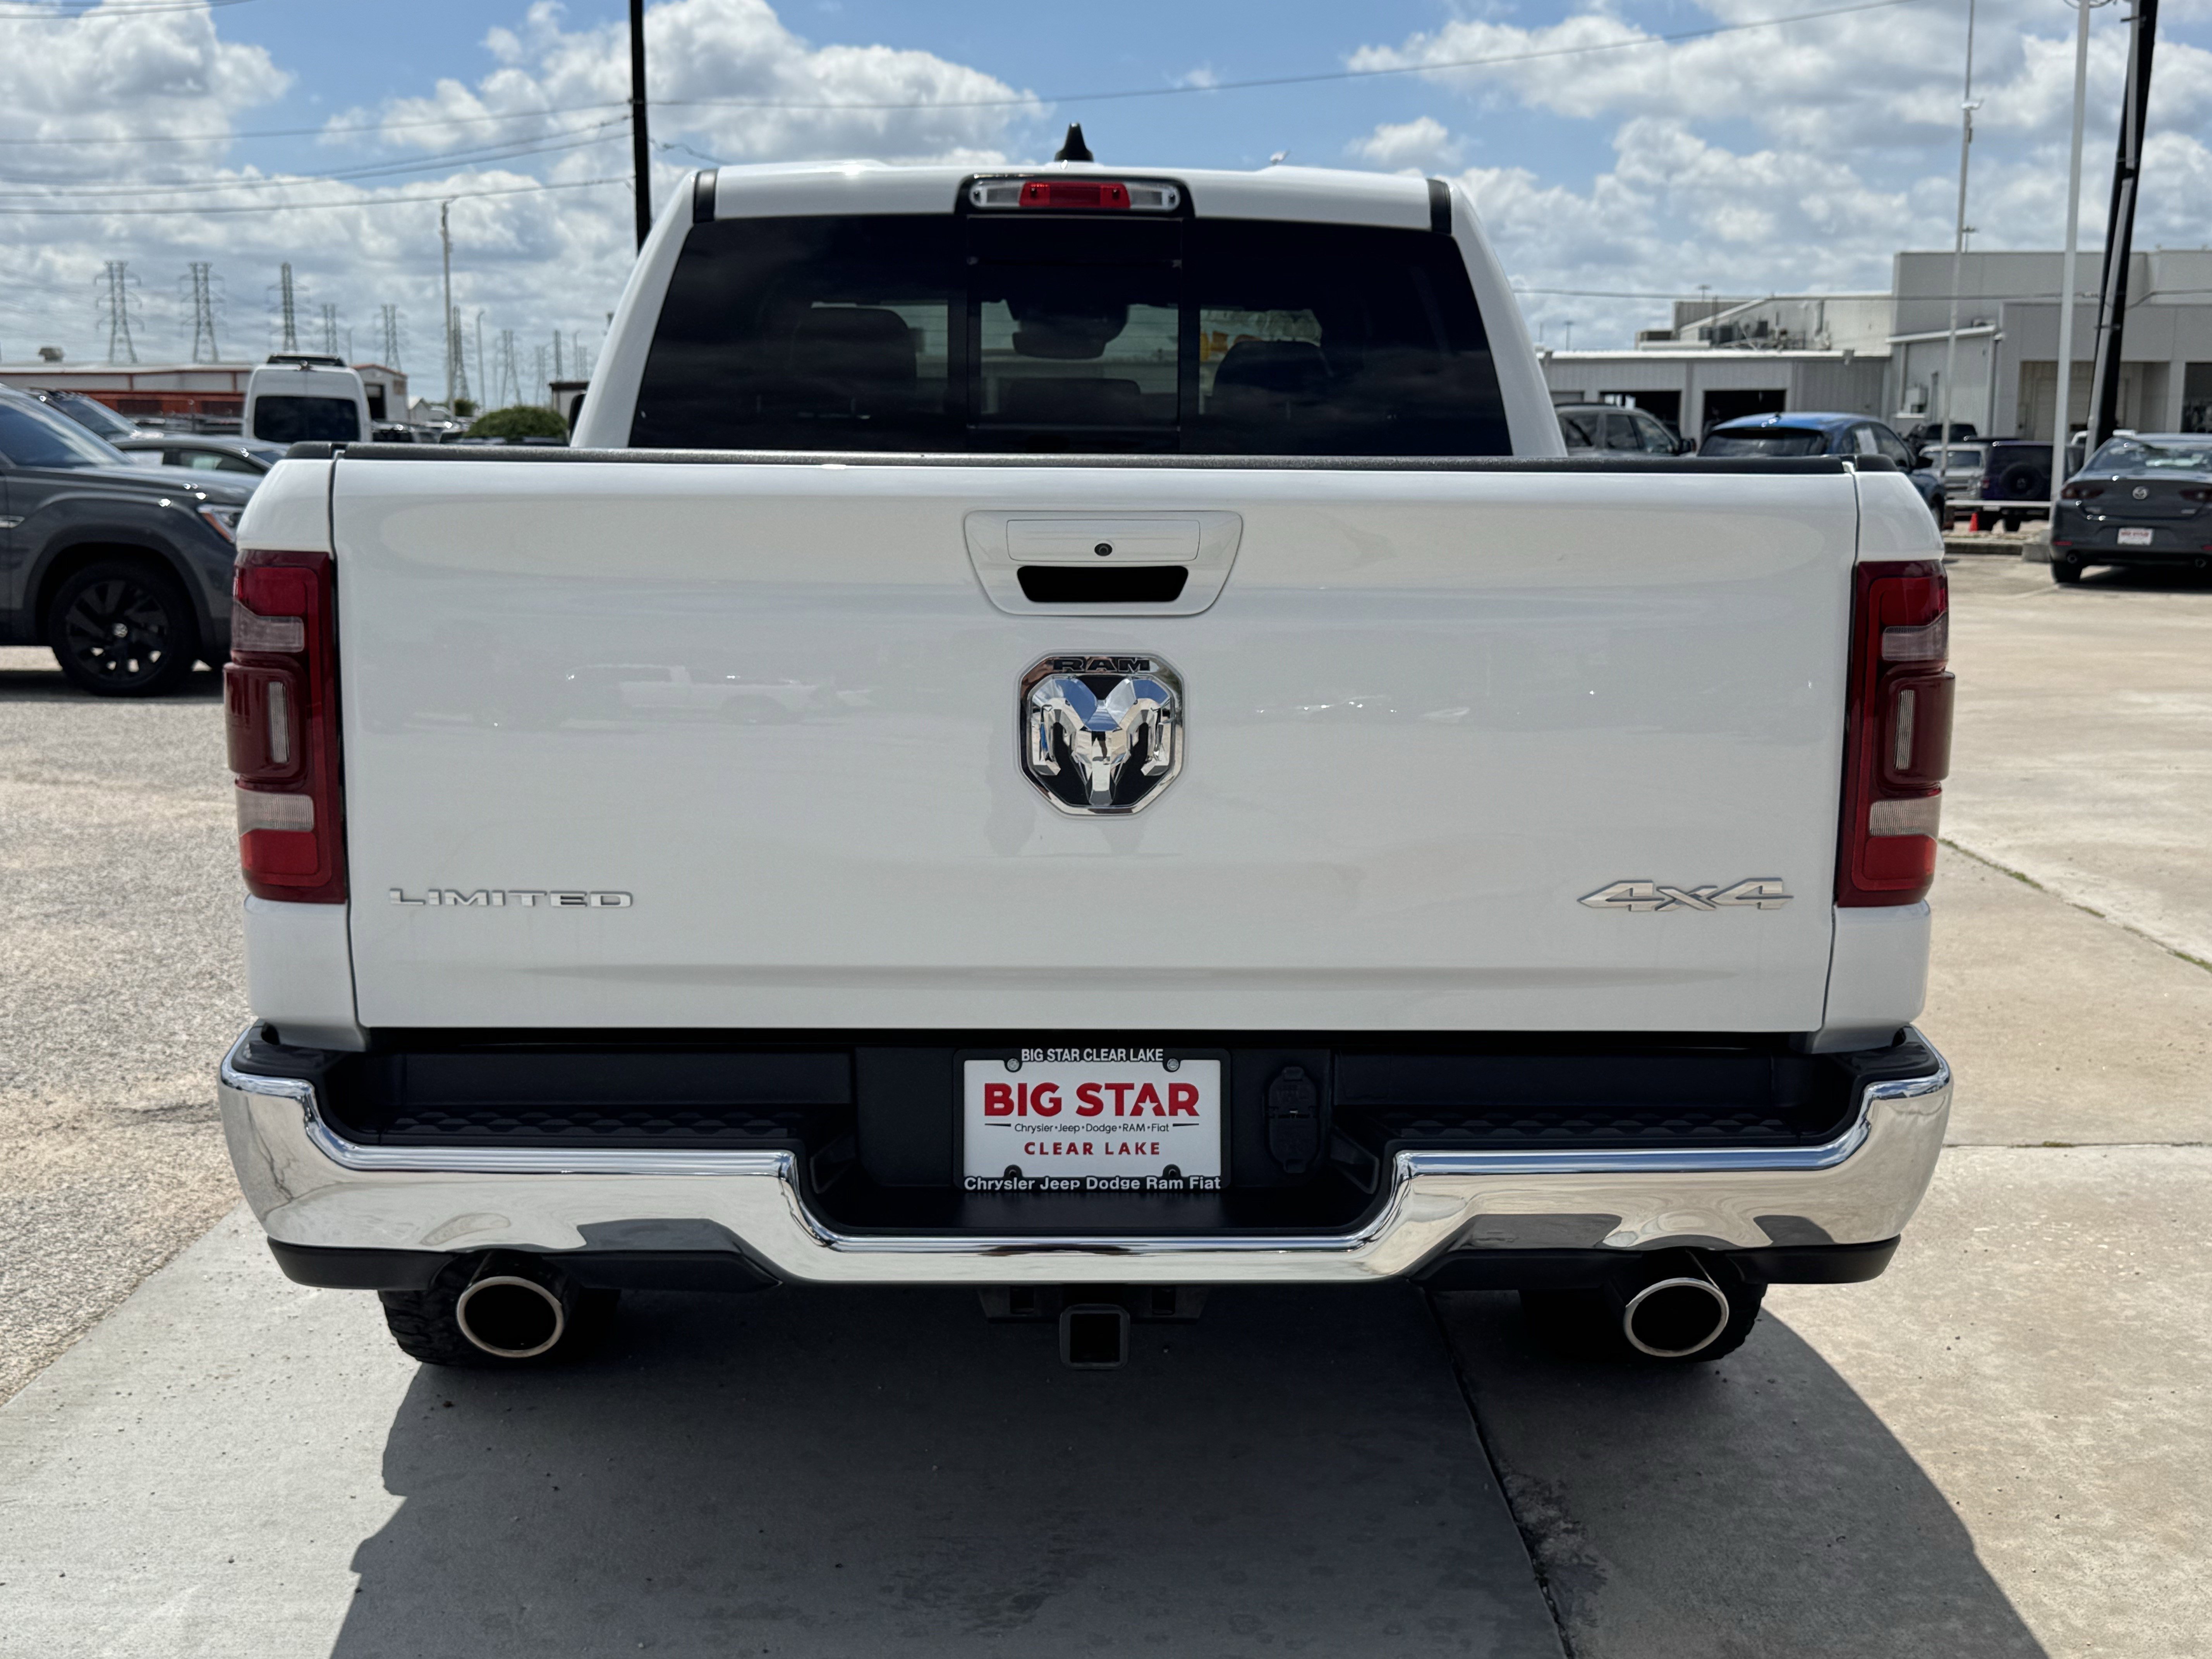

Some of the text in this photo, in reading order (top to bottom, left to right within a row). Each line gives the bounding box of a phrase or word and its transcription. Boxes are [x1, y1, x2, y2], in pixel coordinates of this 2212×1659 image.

[1053, 658, 1151, 672] RAM
[389, 888, 634, 908] LIMITED
[1021, 1048, 1163, 1061] BIG STAR CLEAR LAKE
[984, 1082, 1200, 1117] BIG STAR
[1024, 1142, 1160, 1155] CLEAR LAKE
[964, 1176, 1221, 1190] Chrysler Jeep Dodge Ram Fiat
